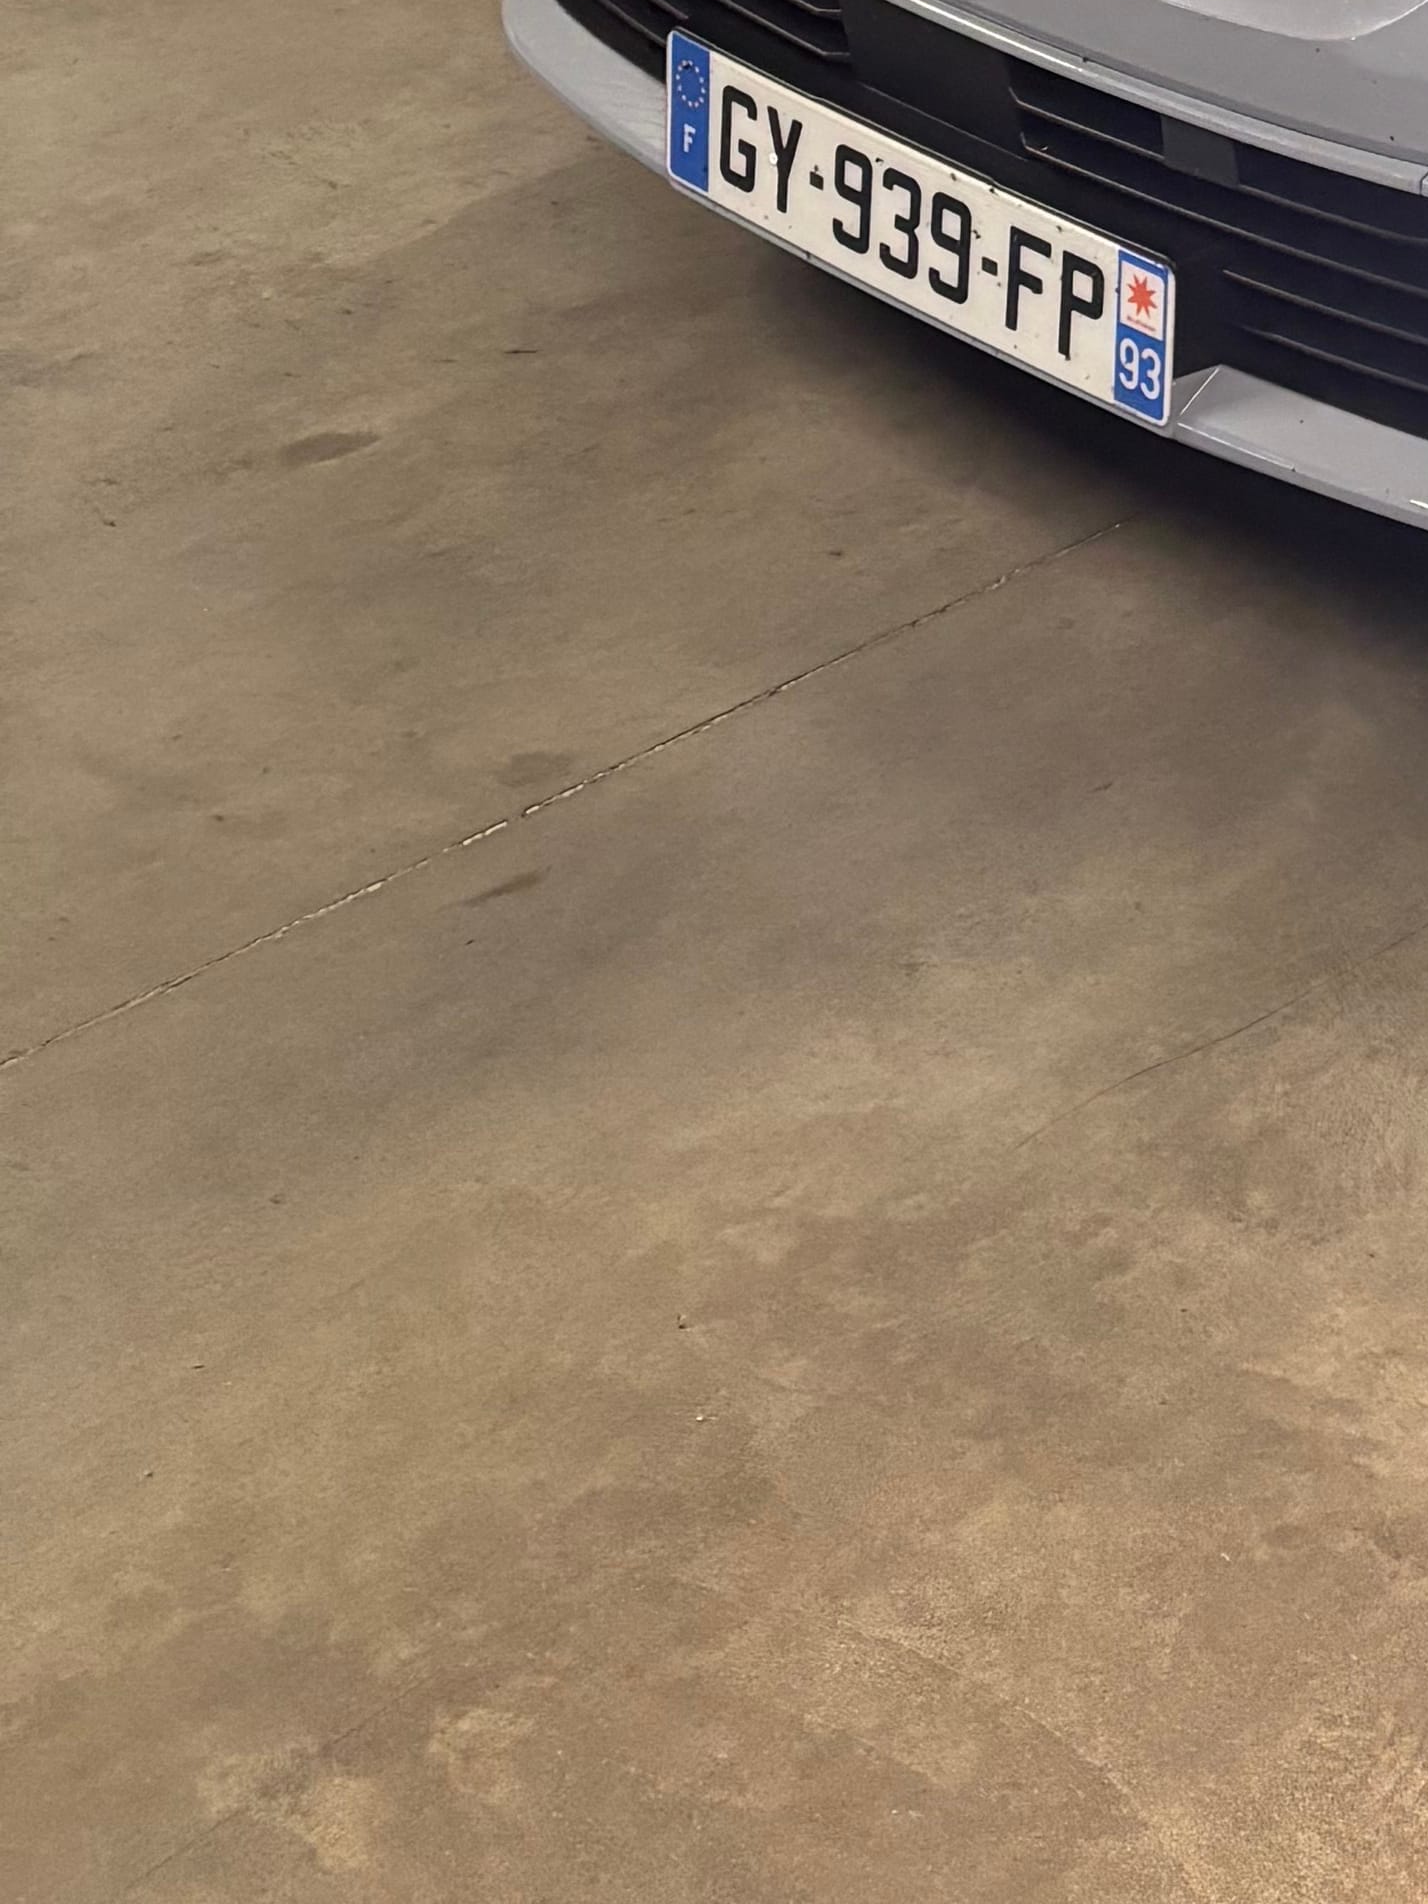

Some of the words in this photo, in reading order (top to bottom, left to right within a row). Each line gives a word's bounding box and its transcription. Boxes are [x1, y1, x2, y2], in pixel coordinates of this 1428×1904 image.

[682, 122, 697, 154] F
[719, 85, 1106, 358] GY-939-FP
[1118, 337, 1162, 401] 93
